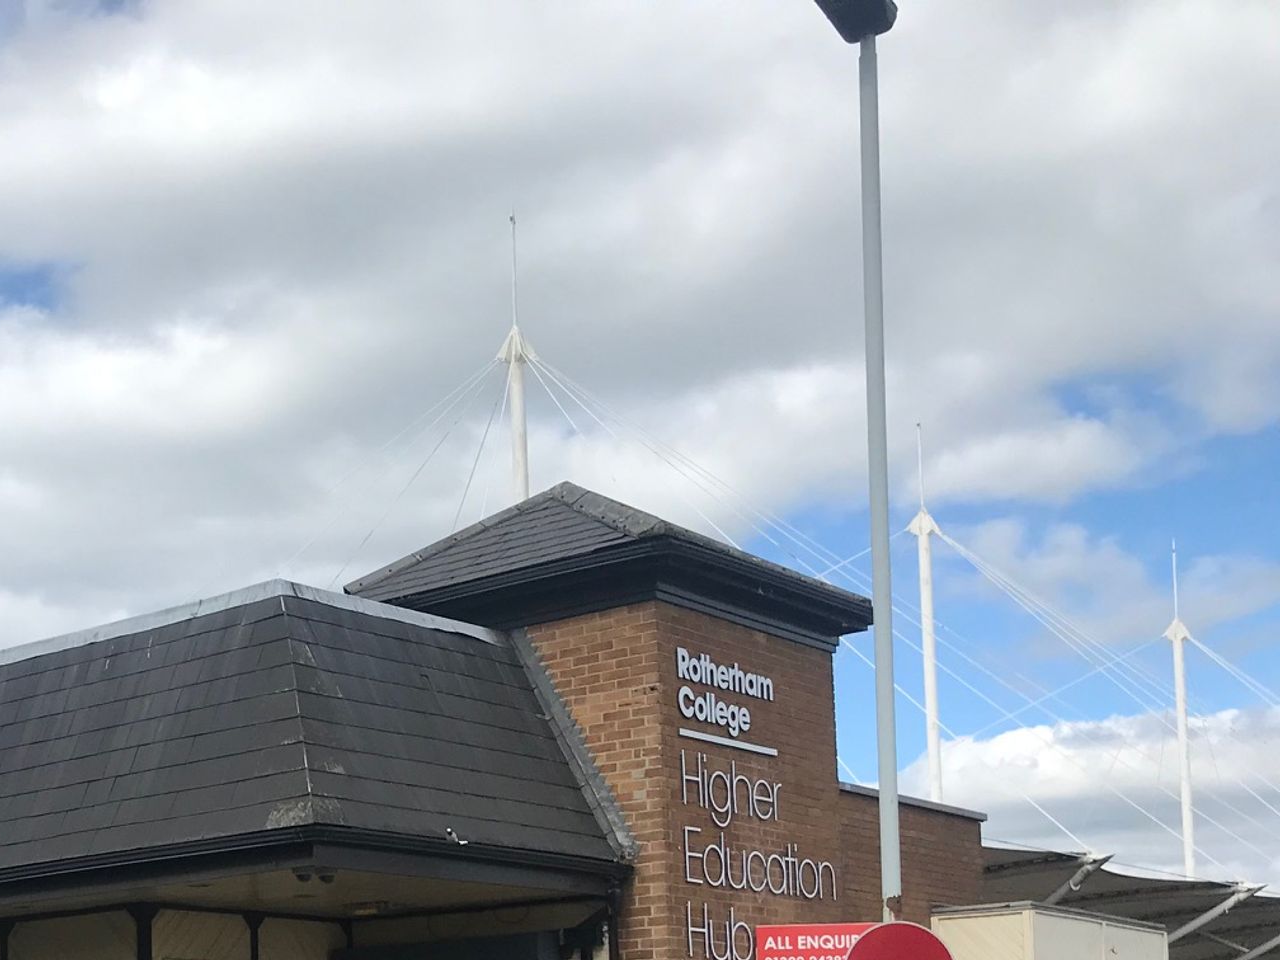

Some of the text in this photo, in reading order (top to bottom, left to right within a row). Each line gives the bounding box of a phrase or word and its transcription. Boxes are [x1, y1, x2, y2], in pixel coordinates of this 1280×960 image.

[677, 647, 774, 701] Rotherham
[678, 686, 751, 737] College
[681, 749, 782, 827] Higher
[684, 826, 837, 900] Education
[764, 936, 793, 950] ALL
